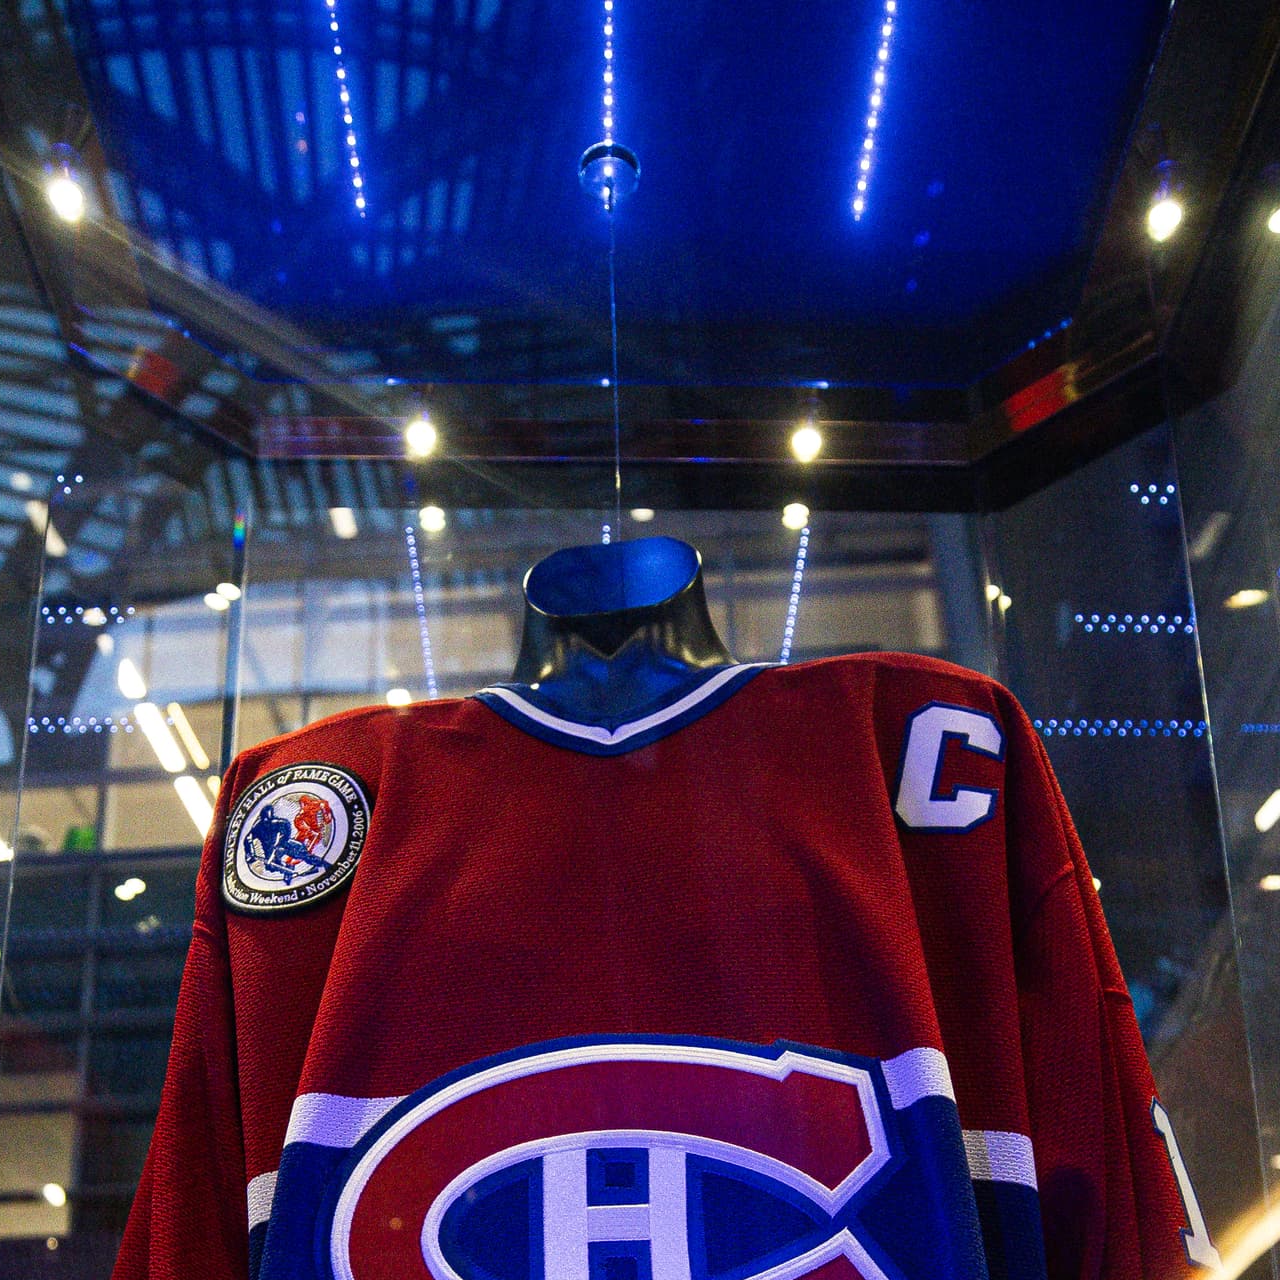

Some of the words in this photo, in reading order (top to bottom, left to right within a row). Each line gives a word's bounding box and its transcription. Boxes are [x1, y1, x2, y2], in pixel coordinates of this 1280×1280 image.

[892, 701, 1007, 833] C
[245, 781, 275, 811] HALL
[277, 771, 292, 785] of
[293, 768, 330, 782] FAME
[329, 774, 357, 804] GAME
[305, 852, 357, 896] November
[249, 889, 298, 904] Weekend
